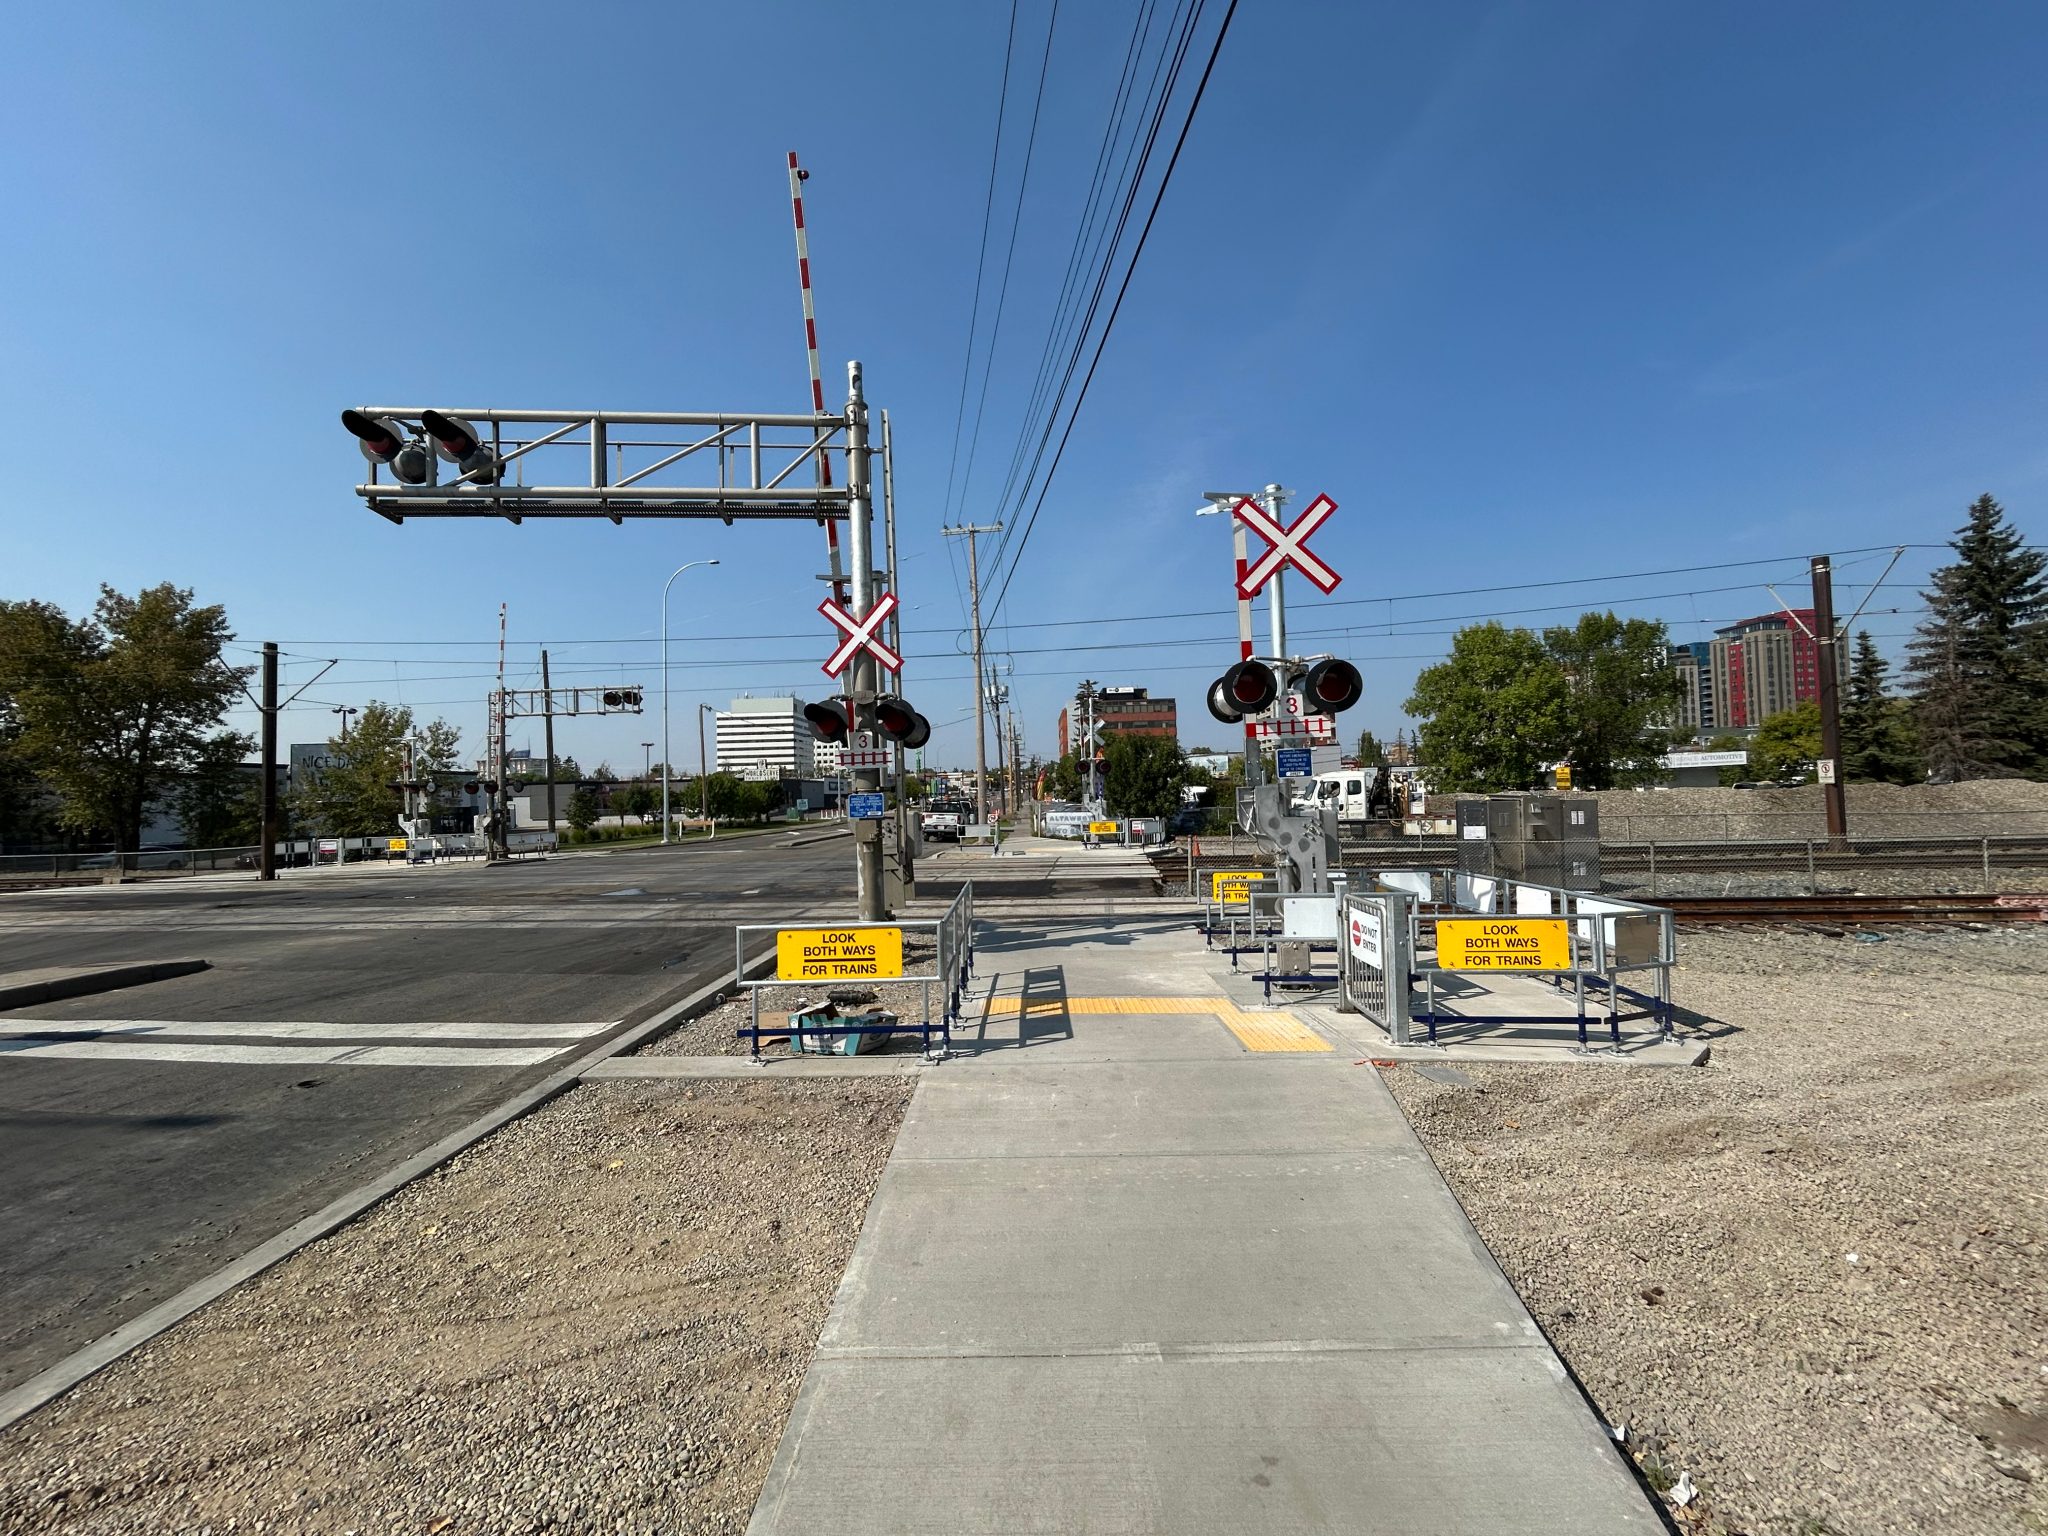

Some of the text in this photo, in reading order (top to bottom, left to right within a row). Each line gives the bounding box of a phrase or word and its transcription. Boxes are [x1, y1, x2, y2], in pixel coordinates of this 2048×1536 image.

[1286, 697, 1298, 714] 3
[858, 735, 868, 748] 3
[1361, 924, 1378, 939] DO NOT
[1483, 925, 1519, 935] LOOK
[822, 933, 856, 944] LOOK
[1465, 938, 1539, 948] BOTH WAYS
[803, 944, 876, 956] BOTH WAYS
[1362, 938, 1377, 953] ENTER
[1465, 956, 1542, 966] FOR TRAINS
[802, 963, 877, 975] FOR TRAINS
